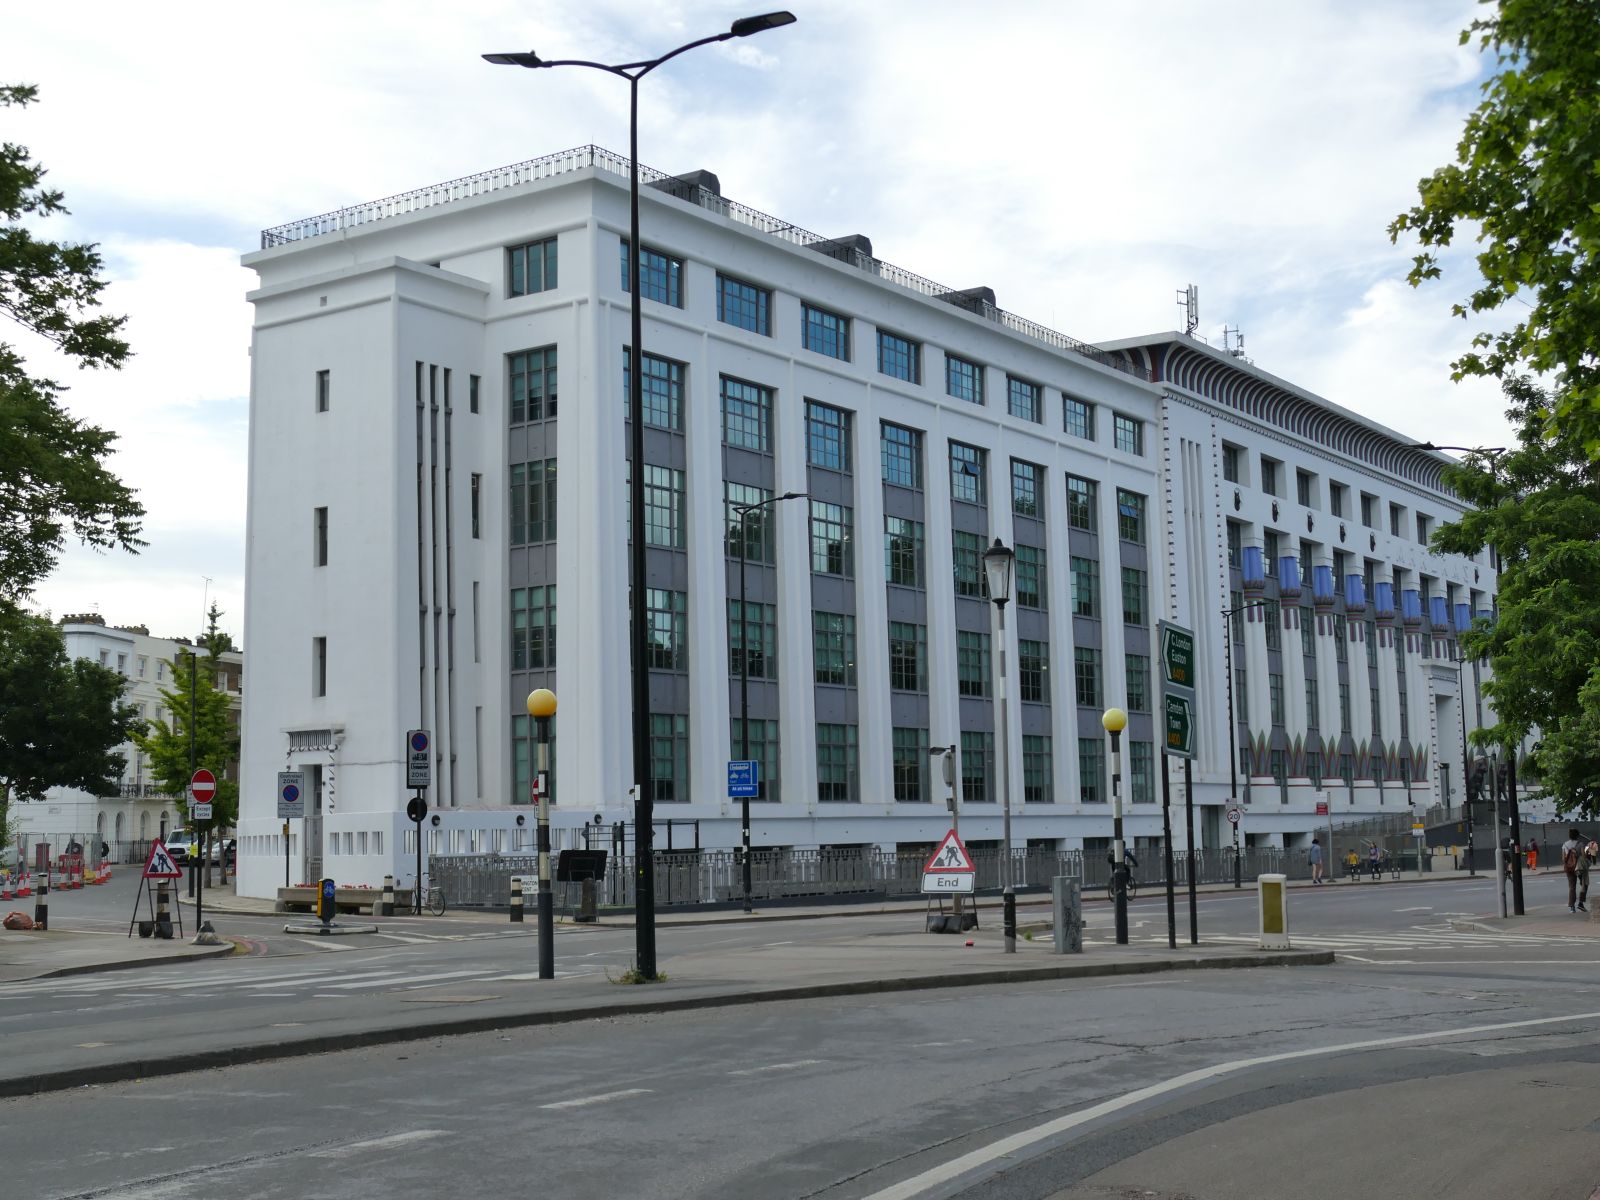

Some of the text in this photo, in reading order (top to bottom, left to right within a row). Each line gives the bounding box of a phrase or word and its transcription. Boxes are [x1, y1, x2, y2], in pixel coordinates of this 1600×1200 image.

[1171, 649, 1187, 665] Euston
[1166, 699, 1184, 715] Camden
[1169, 716, 1181, 730] Town
[937, 877, 959, 887] End
